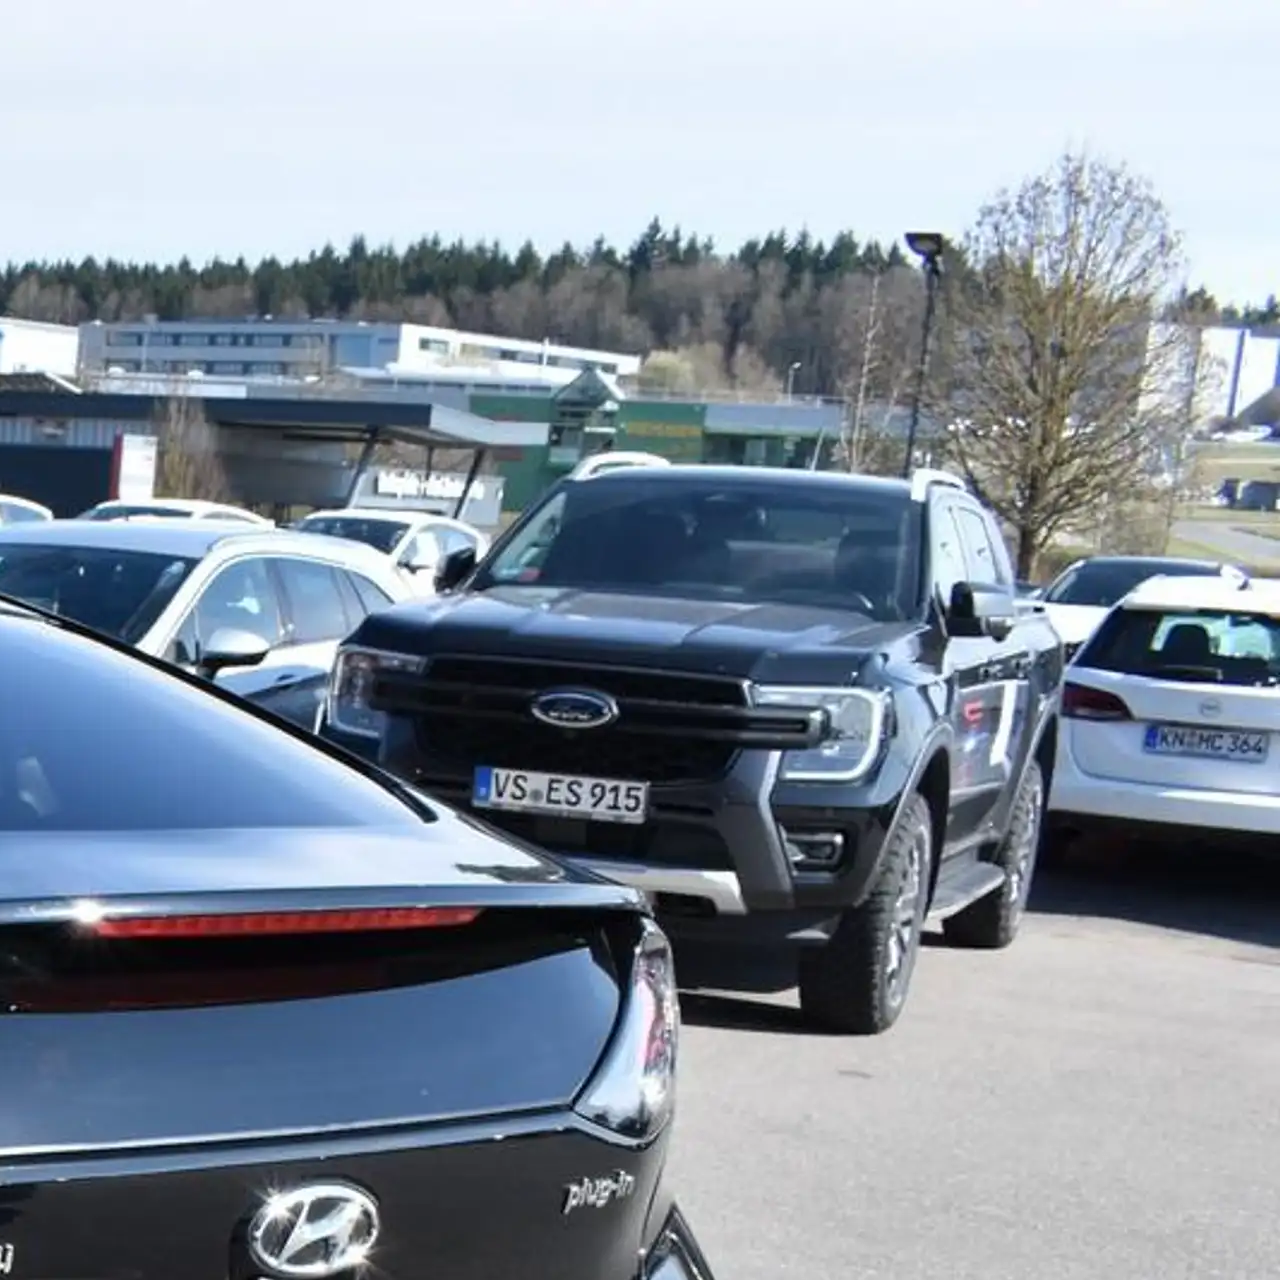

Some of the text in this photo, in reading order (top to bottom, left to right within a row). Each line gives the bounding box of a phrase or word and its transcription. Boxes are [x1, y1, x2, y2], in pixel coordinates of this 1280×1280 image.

[494, 772, 643, 813] VS ES 915
[563, 1169, 635, 1215] plug-in
